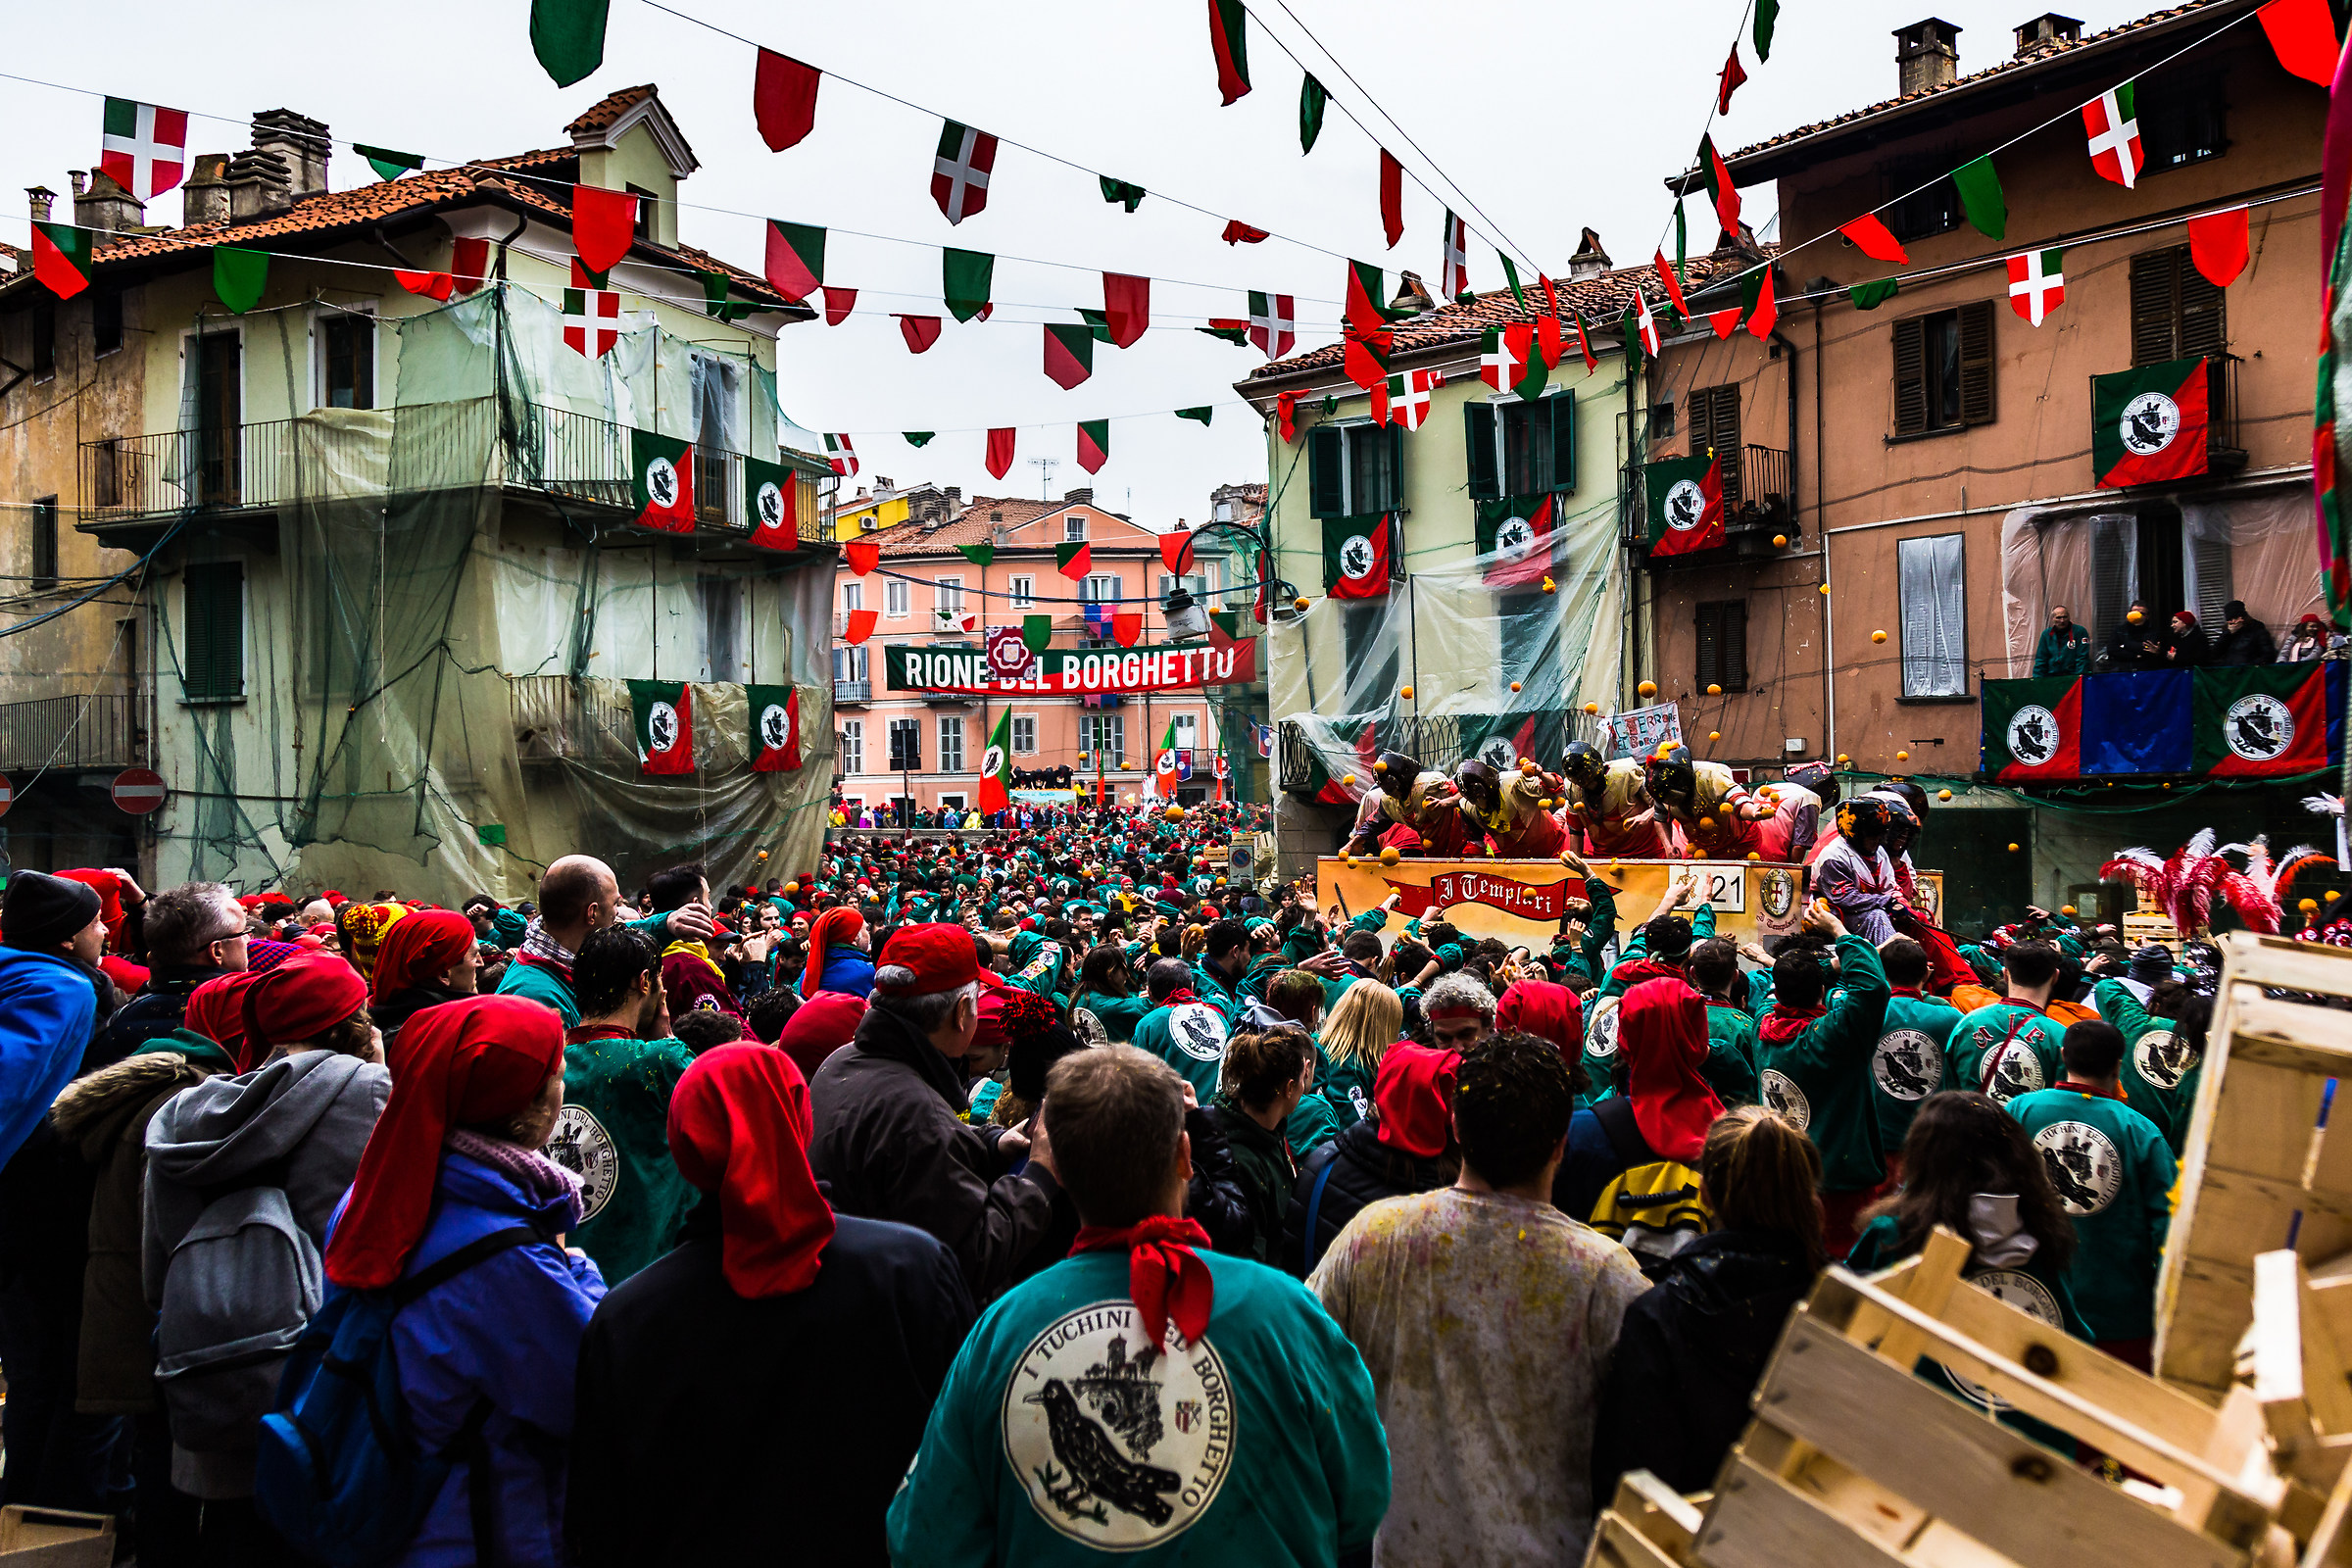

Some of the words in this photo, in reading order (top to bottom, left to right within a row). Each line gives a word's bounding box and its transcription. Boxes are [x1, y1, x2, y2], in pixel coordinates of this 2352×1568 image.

[906, 652, 989, 690] RIONE
[1062, 647, 1235, 690] BORGHETTO
[1711, 875, 1741, 904] 21
[1881, 1031, 1911, 1047] TUCHINI
[1914, 1033, 1929, 1046] DEL
[2042, 1125, 2082, 1141] TUCHINI
[2085, 1130, 2104, 1147] DEL
[574, 1110, 589, 1127] DEL
[589, 1126, 612, 1200] BORGHETTO
[1980, 1273, 2008, 1289] DEL
[1023, 1366, 1039, 1380] I
[1036, 1309, 1132, 1362] TUCHINI
[1182, 1356, 1229, 1508] BORGHETTO
